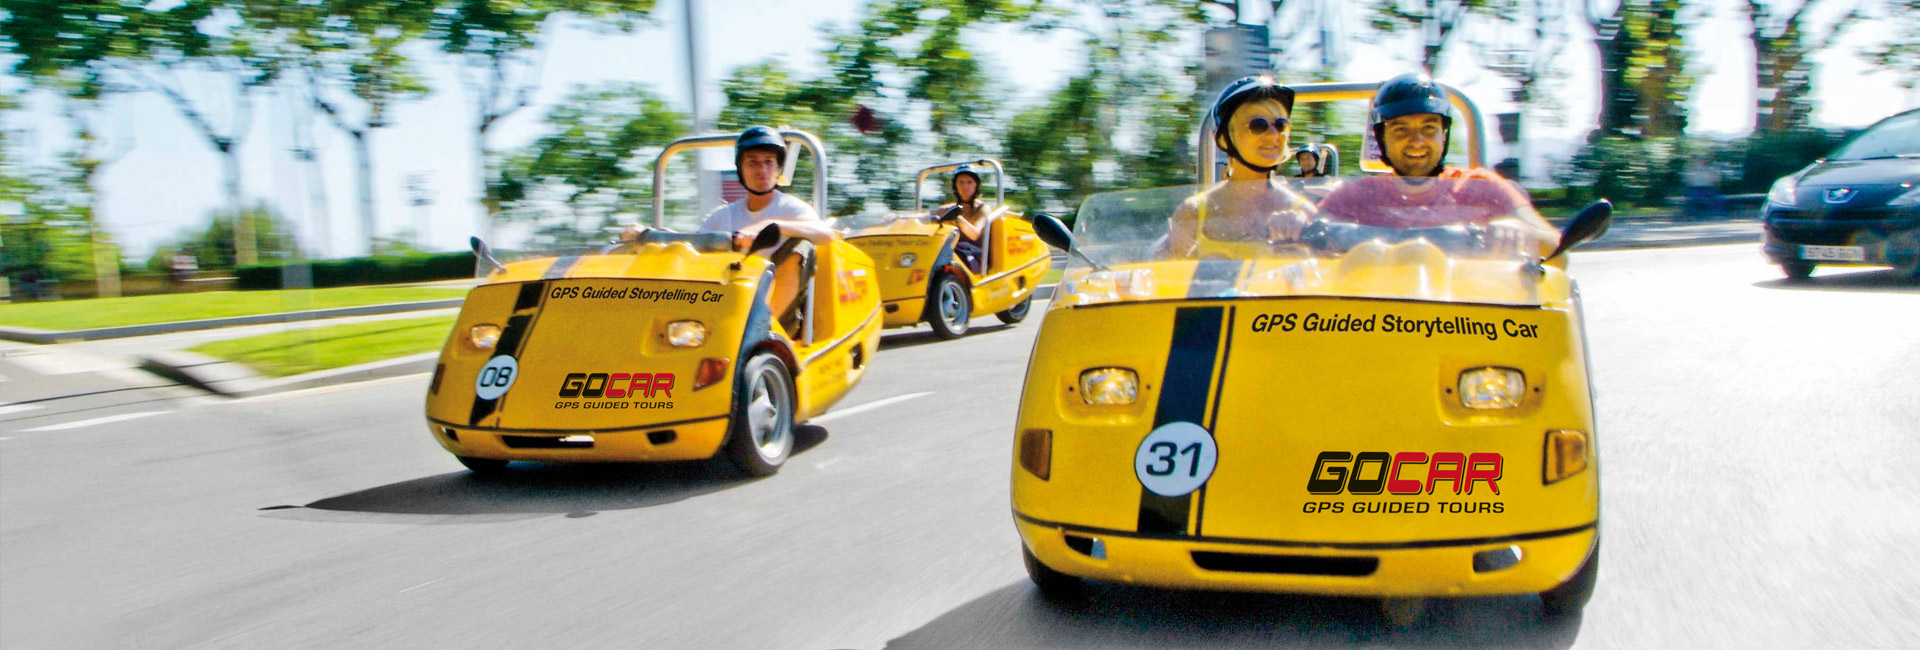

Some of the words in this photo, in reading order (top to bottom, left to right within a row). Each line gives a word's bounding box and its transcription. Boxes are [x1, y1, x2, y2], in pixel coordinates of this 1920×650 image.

[550, 286, 580, 299] GPS
[581, 286, 628, 299] Guided
[628, 286, 698, 304] Storytelling
[701, 290, 724, 303] Car
[1251, 313, 1298, 333] GPS
[1303, 312, 1377, 332] Guided
[1382, 314, 1498, 341] Storytelling
[1503, 318, 1540, 339] Car
[480, 366, 513, 388] 08
[558, 372, 676, 398] GOCAR
[554, 401, 580, 409] GPS
[583, 401, 629, 409] GUIDED
[633, 401, 674, 409] TOURS
[1145, 441, 1204, 478] 31
[1306, 451, 1504, 495] GOCAR
[1302, 501, 1345, 514] GPS
[1352, 501, 1430, 514] GUIDED
[1437, 502, 1505, 514] TOURS
